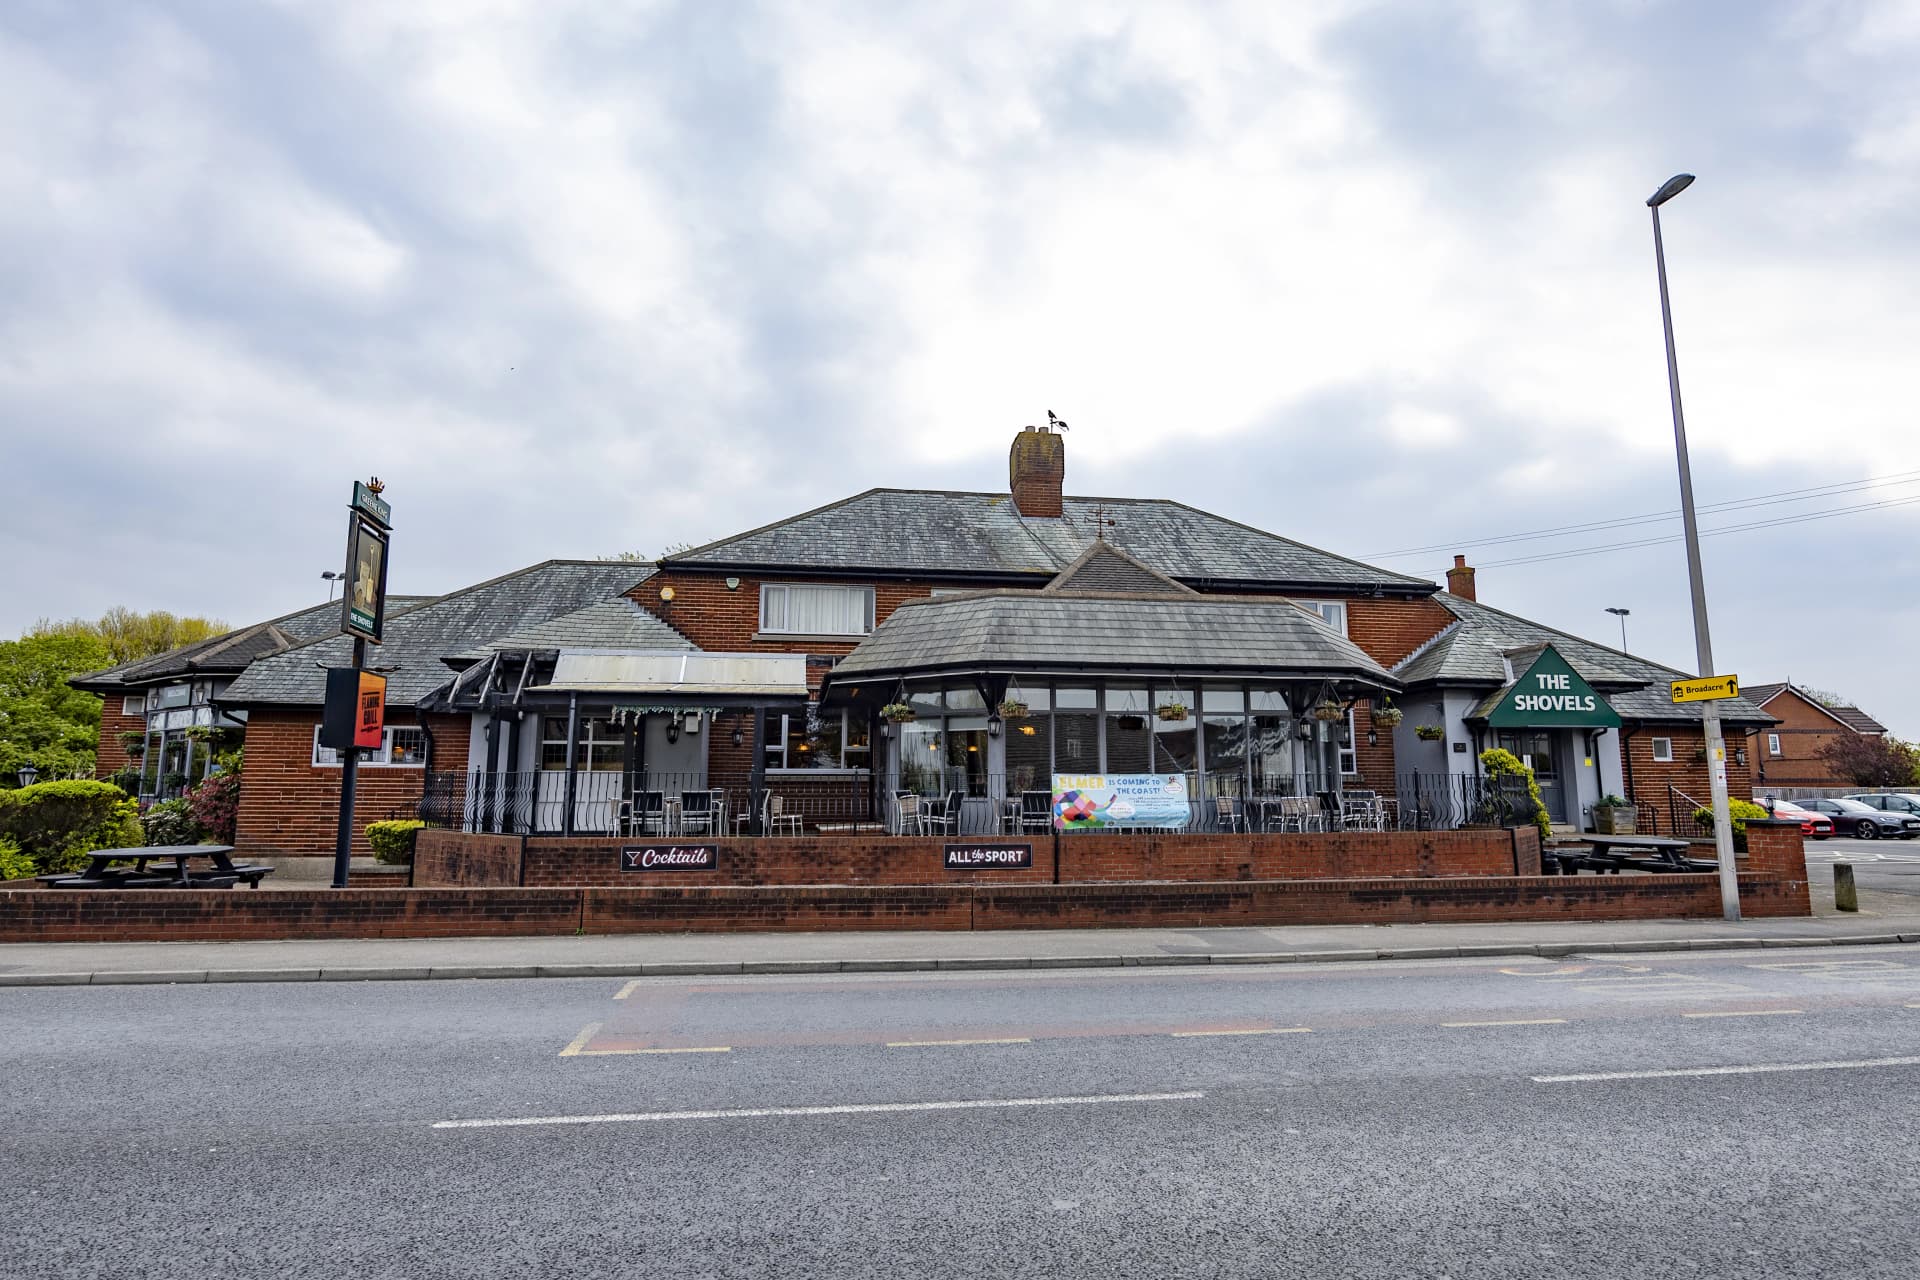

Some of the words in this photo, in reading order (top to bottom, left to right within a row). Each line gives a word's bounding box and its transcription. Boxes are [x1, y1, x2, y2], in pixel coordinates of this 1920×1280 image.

[1535, 674, 1570, 690] THE
[1686, 684, 1724, 693] Broadacre
[1514, 694, 1596, 711] SHOVELS
[363, 708, 377, 725] GRILL
[1058, 776, 1105, 789] ELMER
[1117, 778, 1150, 786] COMING
[1116, 787, 1131, 795] THE
[1132, 787, 1160, 795] COAST!
[642, 847, 707, 868] Cocktails
[948, 851, 971, 863] ALL
[971, 849, 985, 863] the
[985, 850, 1023, 862] SPORT
